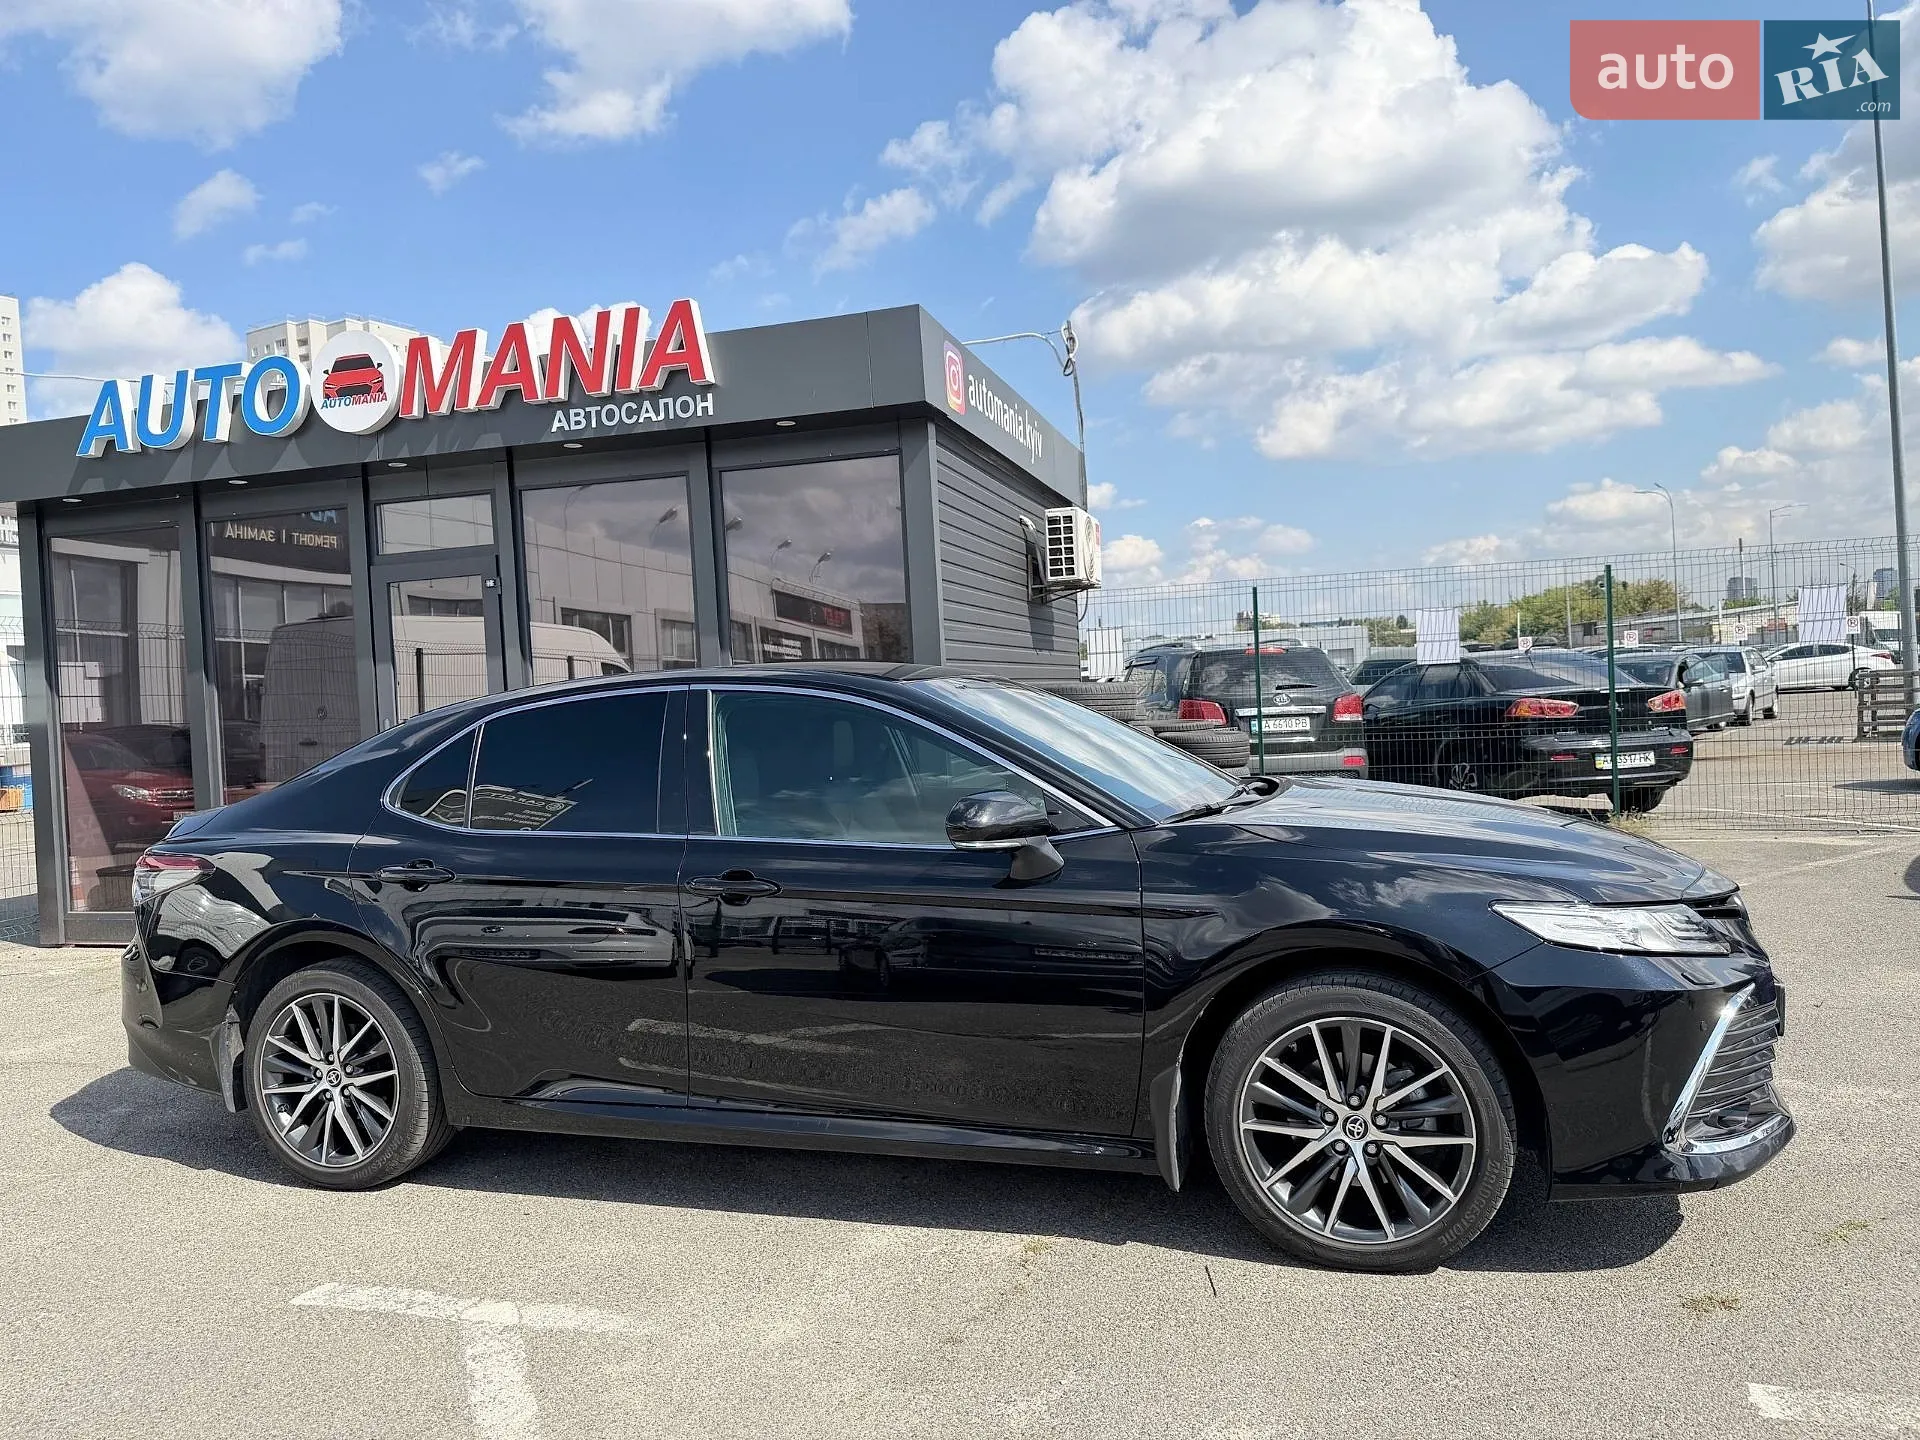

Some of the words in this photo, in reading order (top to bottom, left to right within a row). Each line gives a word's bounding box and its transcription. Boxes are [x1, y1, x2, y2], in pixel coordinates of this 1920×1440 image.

[75, 354, 310, 458] AUTO
[399, 298, 716, 420] MANIA
[320, 392, 389, 410] AUTOMANIA
[551, 393, 714, 434] АВТОСАЛОН
[968, 373, 1043, 465] automania.kyiv
